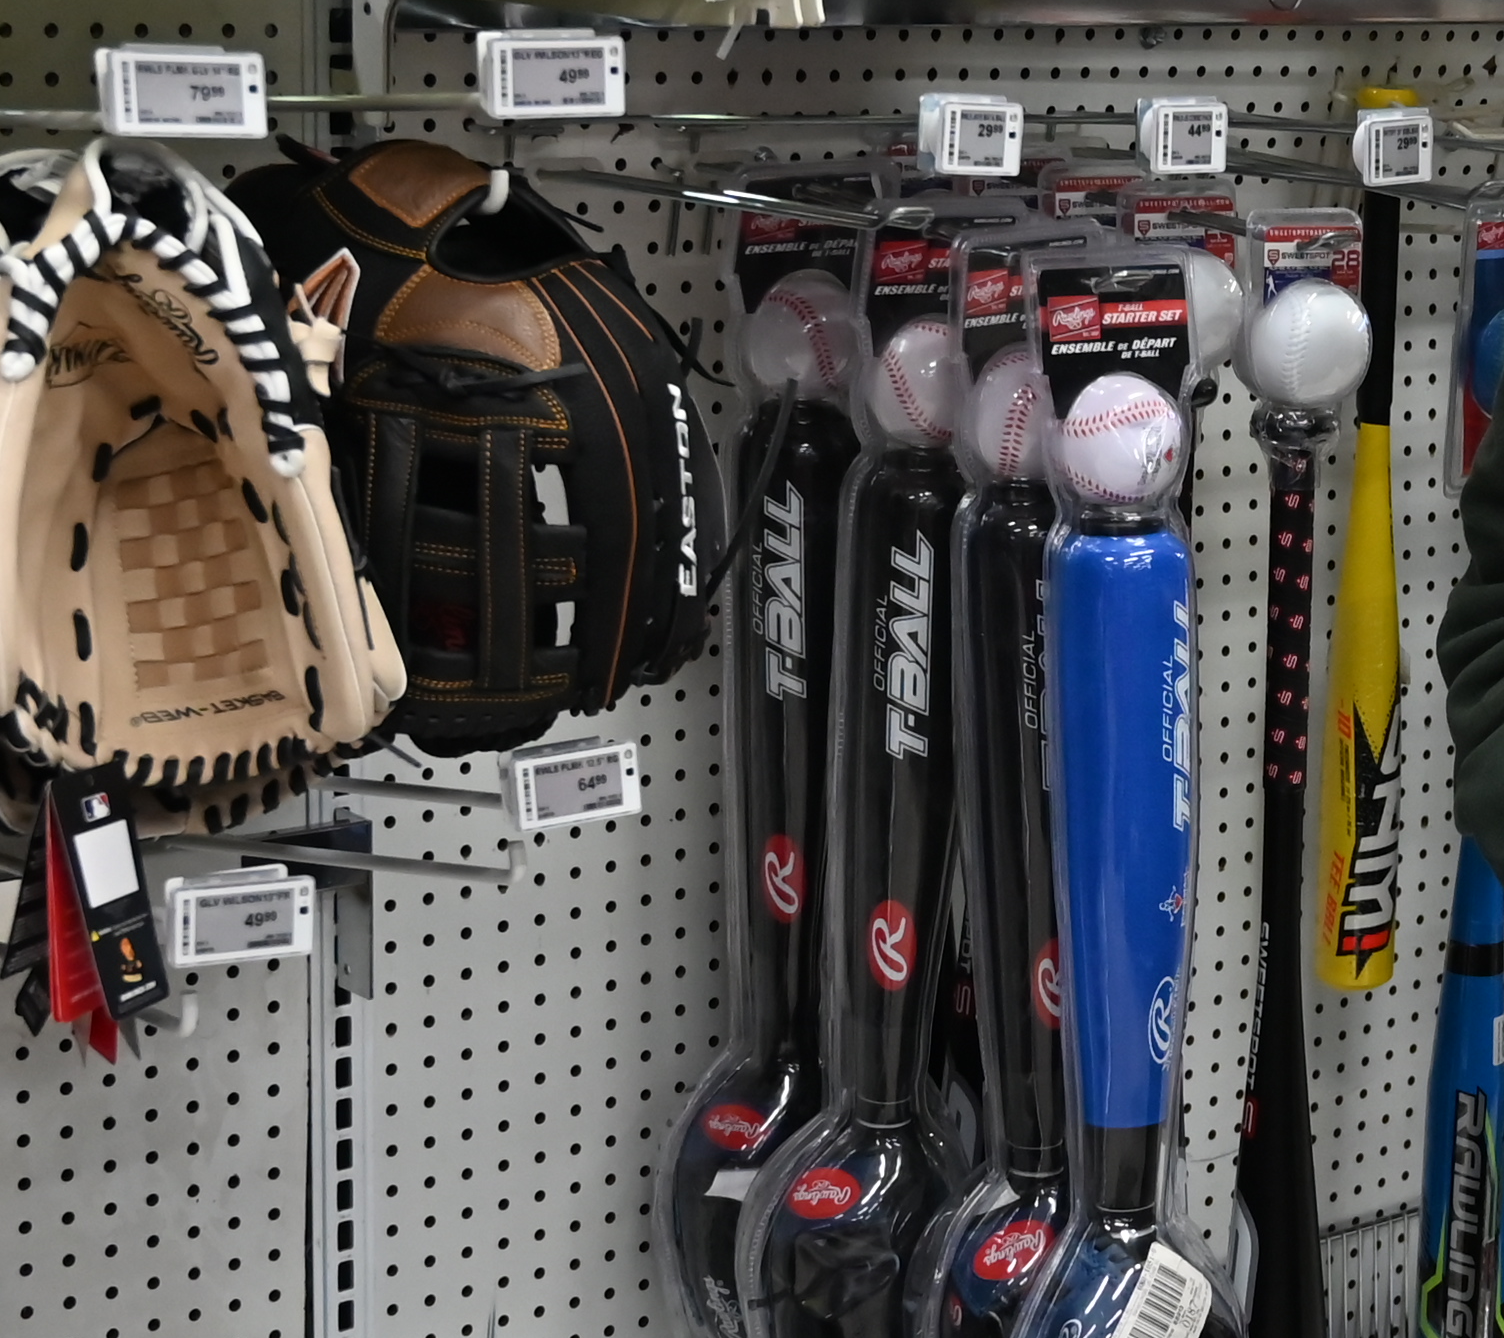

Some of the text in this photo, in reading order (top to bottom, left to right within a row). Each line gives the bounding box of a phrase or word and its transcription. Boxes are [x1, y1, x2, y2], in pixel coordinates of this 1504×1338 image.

[1280, 251, 1330, 260] SWEETSPOT
[874, 282, 935, 297] ENSEMBLE
[1117, 303, 1144, 312] T-BALL
[963, 312, 1018, 330] ENSEMBLE
[1051, 304, 1184, 328] Rawlings STARTER SET
[1050, 336, 1177, 356] ENSEMBLE DÉPART
[666, 382, 698, 597] EASTON
[751, 541, 764, 636] OFFICIAL
[763, 478, 807, 701] T-BALL
[872, 593, 889, 692] OFFICIAL
[885, 528, 935, 760] T-BALL
[1023, 629, 1038, 731] OFFICIAL
[1161, 653, 1174, 763] OFFICIAL
[1327, 850, 1346, 894] TEE
[1247, 920, 1271, 1092] SWEETSPOT
[793, 1179, 853, 1206] Rawlings
[982, 1228, 1047, 1268] Rawlings
